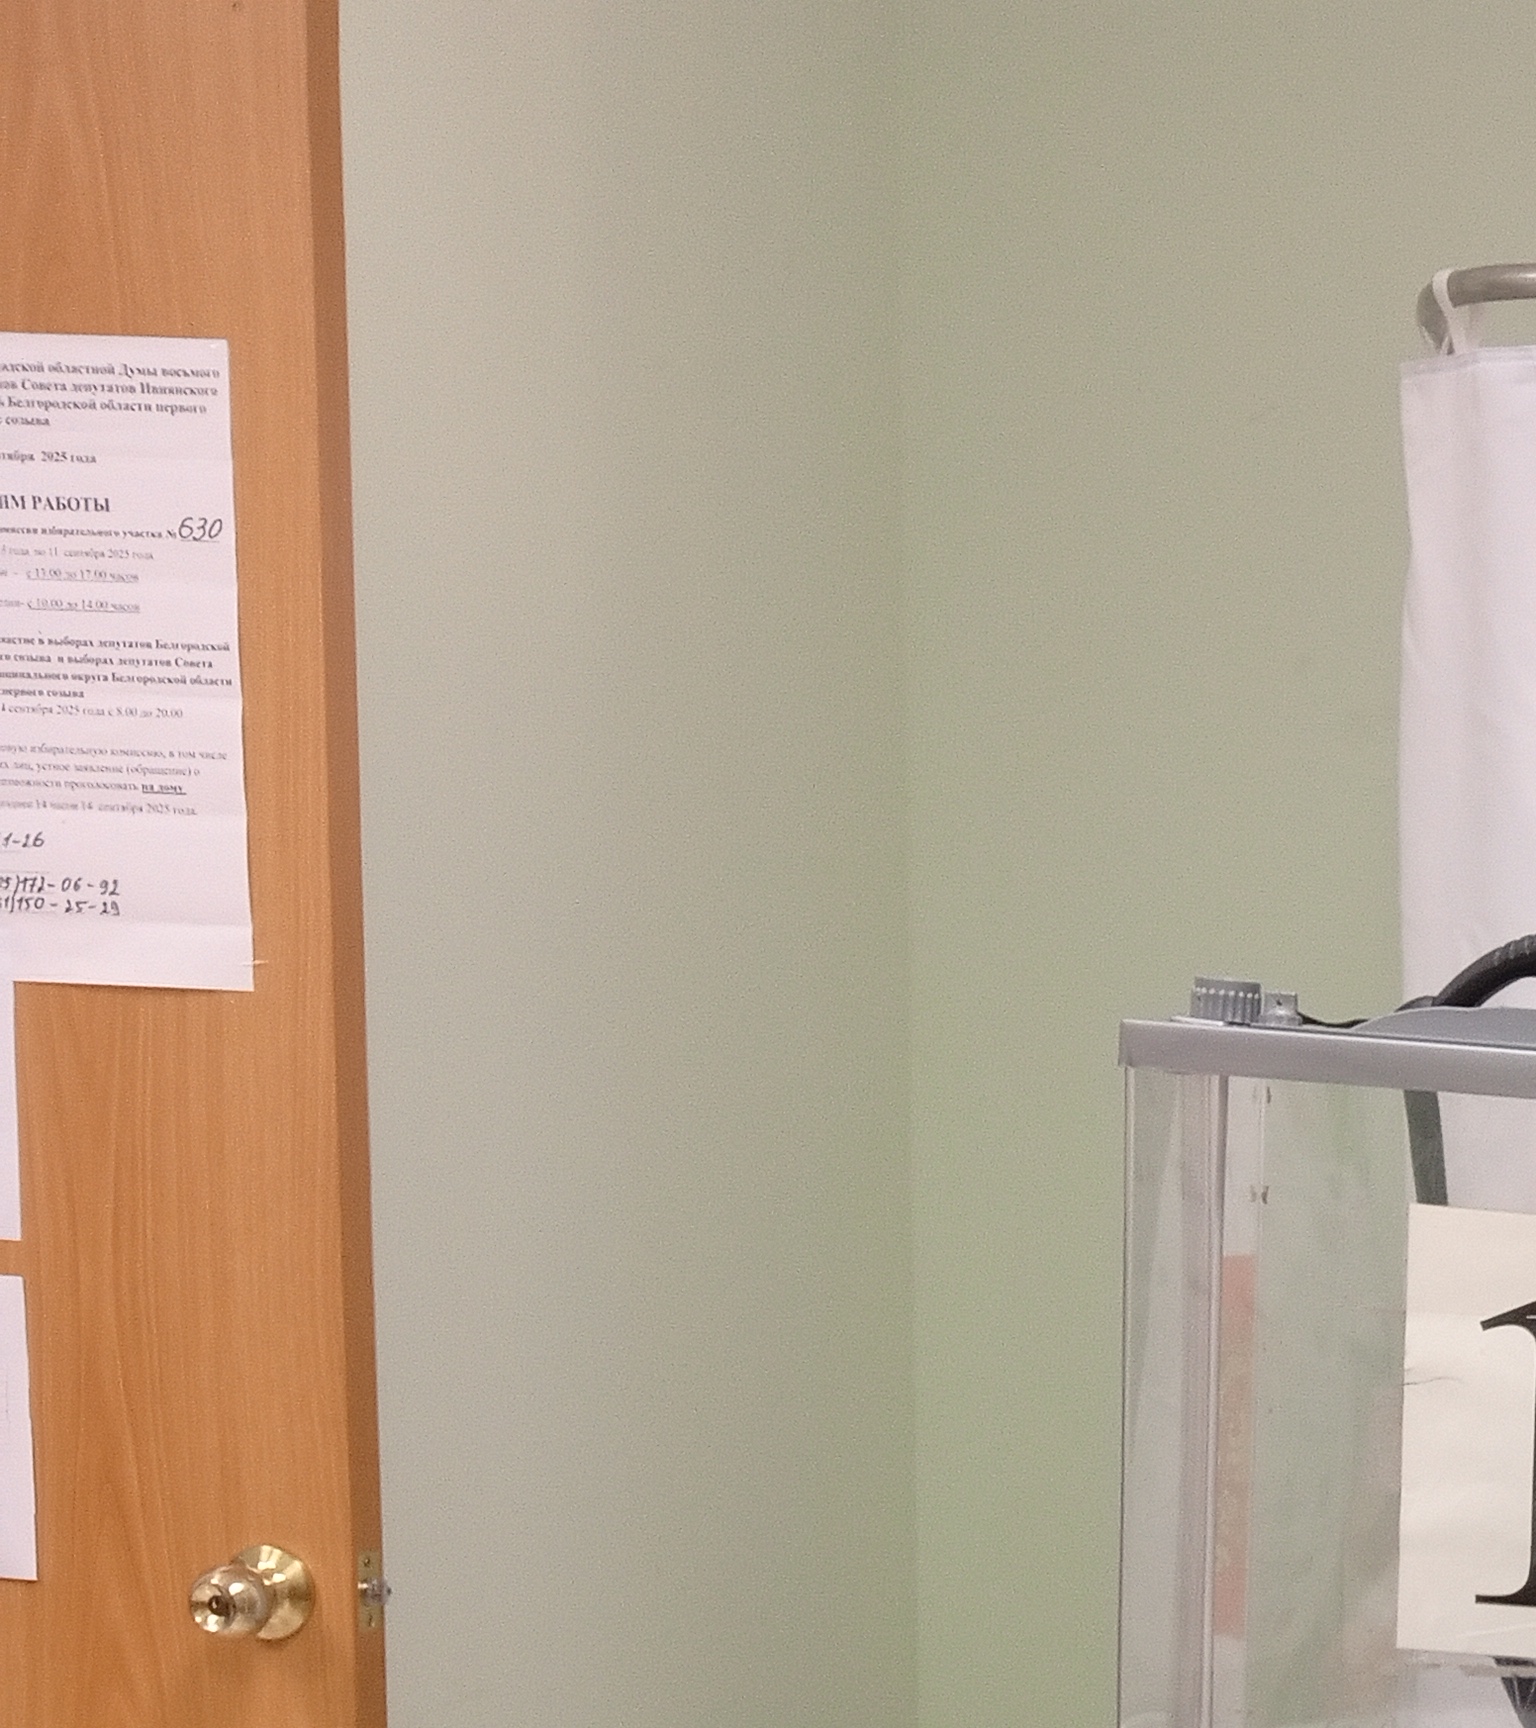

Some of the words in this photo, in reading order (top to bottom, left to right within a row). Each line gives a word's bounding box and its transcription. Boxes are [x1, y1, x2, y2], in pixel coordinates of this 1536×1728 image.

[47, 361, 115, 375] областной
[119, 363, 158, 379] Думы
[160, 368, 220, 378] восьмого
[21, 379, 67, 392] Совета
[70, 383, 136, 396] депутатов
[7, 396, 97, 412] Белгородской
[99, 399, 152, 412] области
[155, 403, 207, 416] первого
[5, 416, 50, 426] созыва
[41, 451, 67, 462] 2025
[70, 455, 97, 463] года
[31, 494, 110, 512] РАБОТЫ
[179, 516, 223, 541] 630
[47, 636, 95, 649] выборах
[98, 639, 153, 651] депутатов
[155, 639, 231, 653] Белгородской
[67, 653, 115, 667] выборах
[117, 658, 172, 668] депутатов
[174, 657, 214, 669] Совета
[111, 672, 188, 686] Белгородской
[189, 675, 233, 686] области
[56, 704, 80, 716] 2025
[155, 708, 184, 718] 20.00
